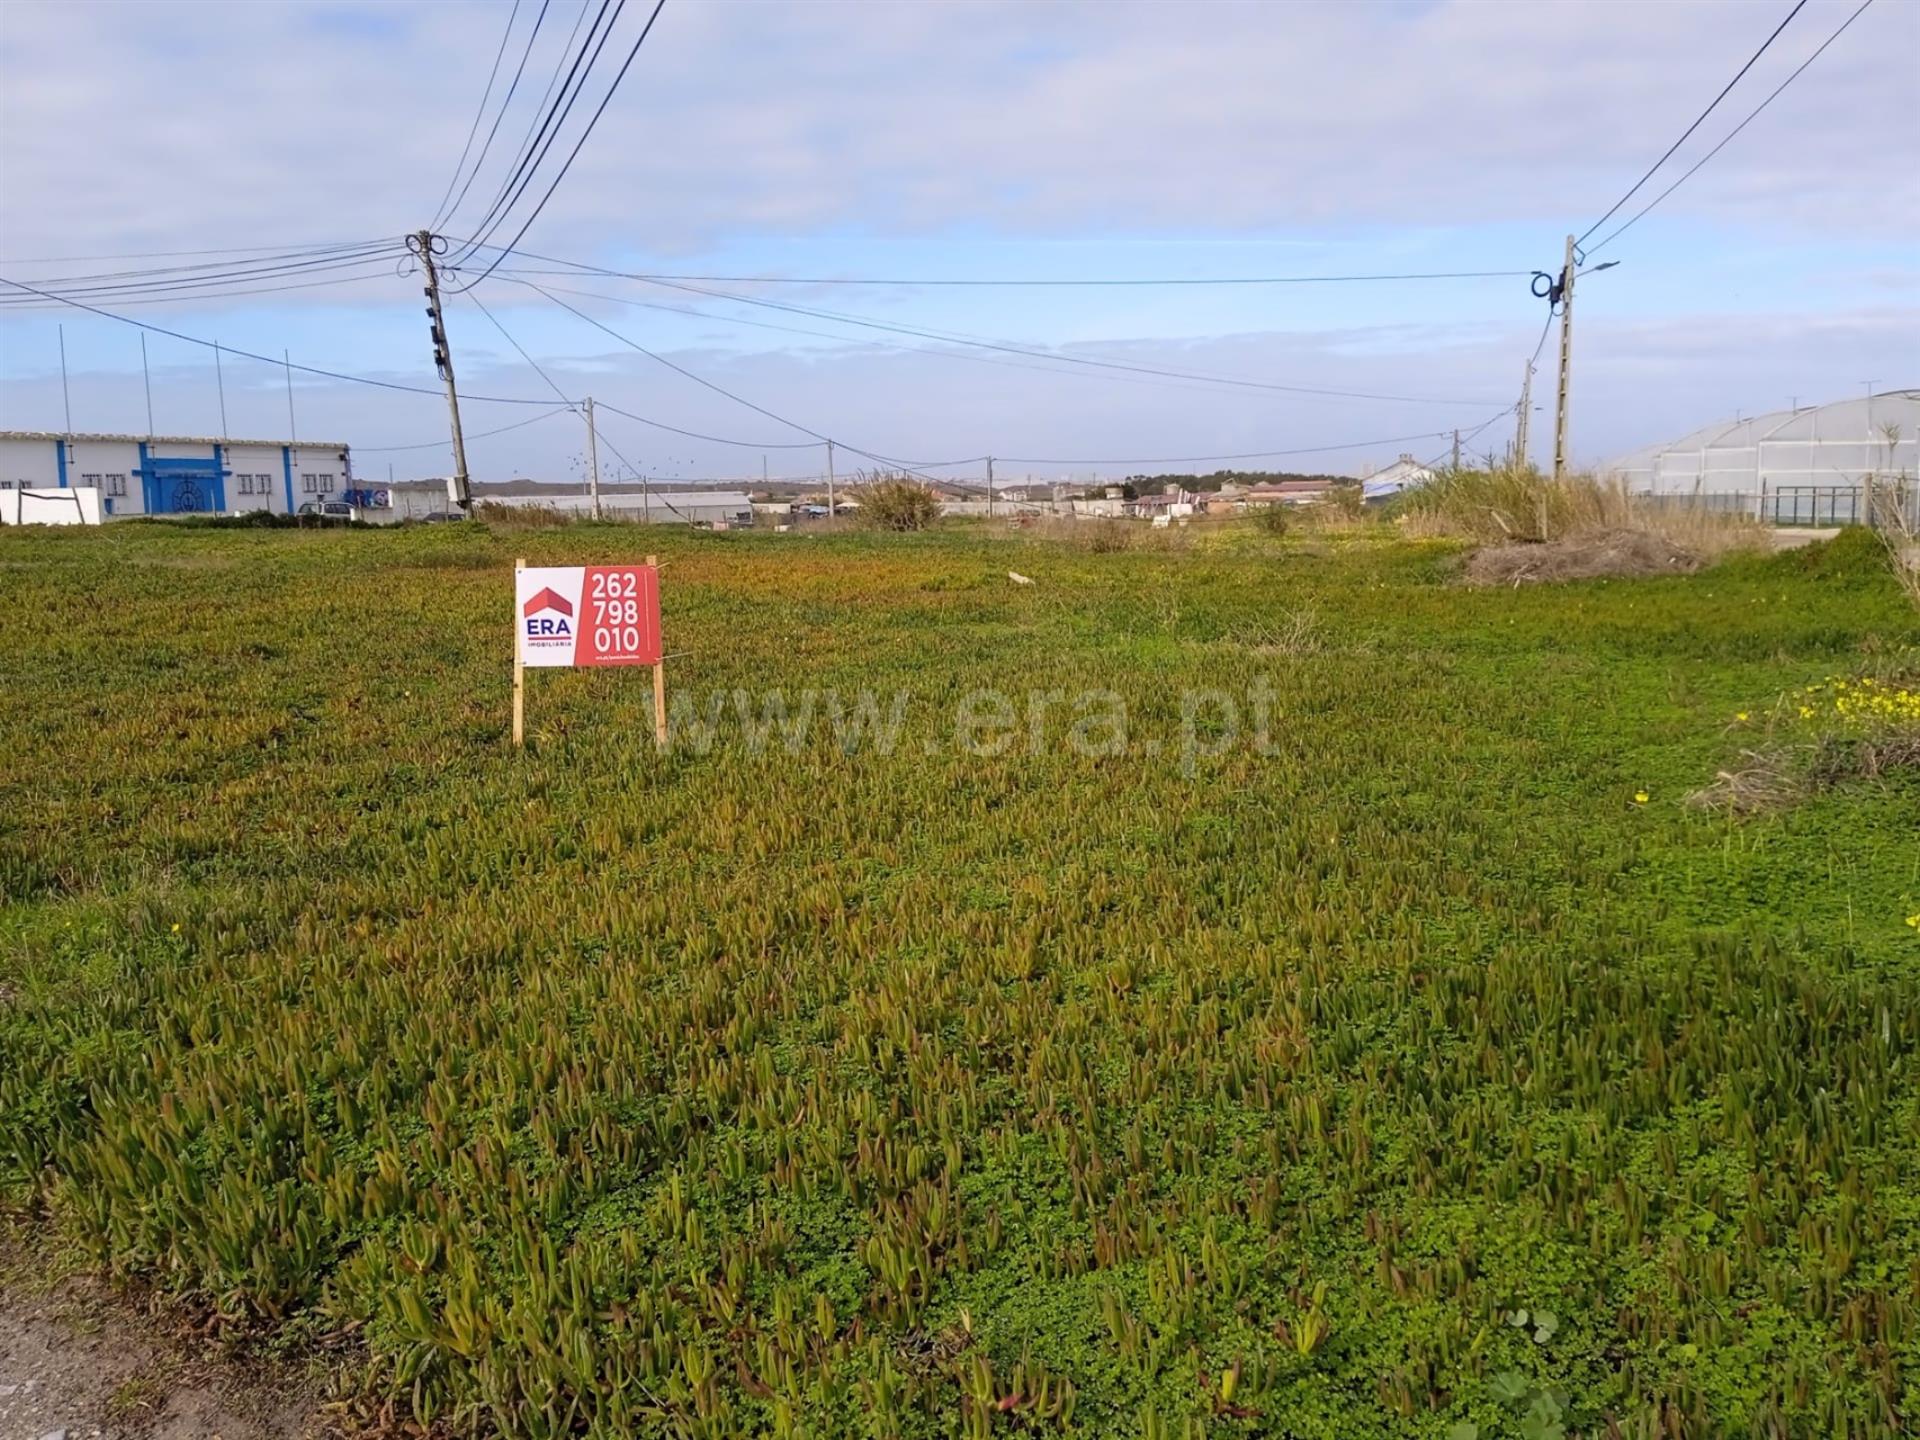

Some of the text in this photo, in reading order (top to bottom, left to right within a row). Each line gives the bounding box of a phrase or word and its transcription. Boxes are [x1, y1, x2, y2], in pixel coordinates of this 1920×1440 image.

[592, 573, 637, 597] 262
[593, 600, 638, 625] 798
[527, 619, 571, 635] ERA
[594, 627, 639, 652] 010
